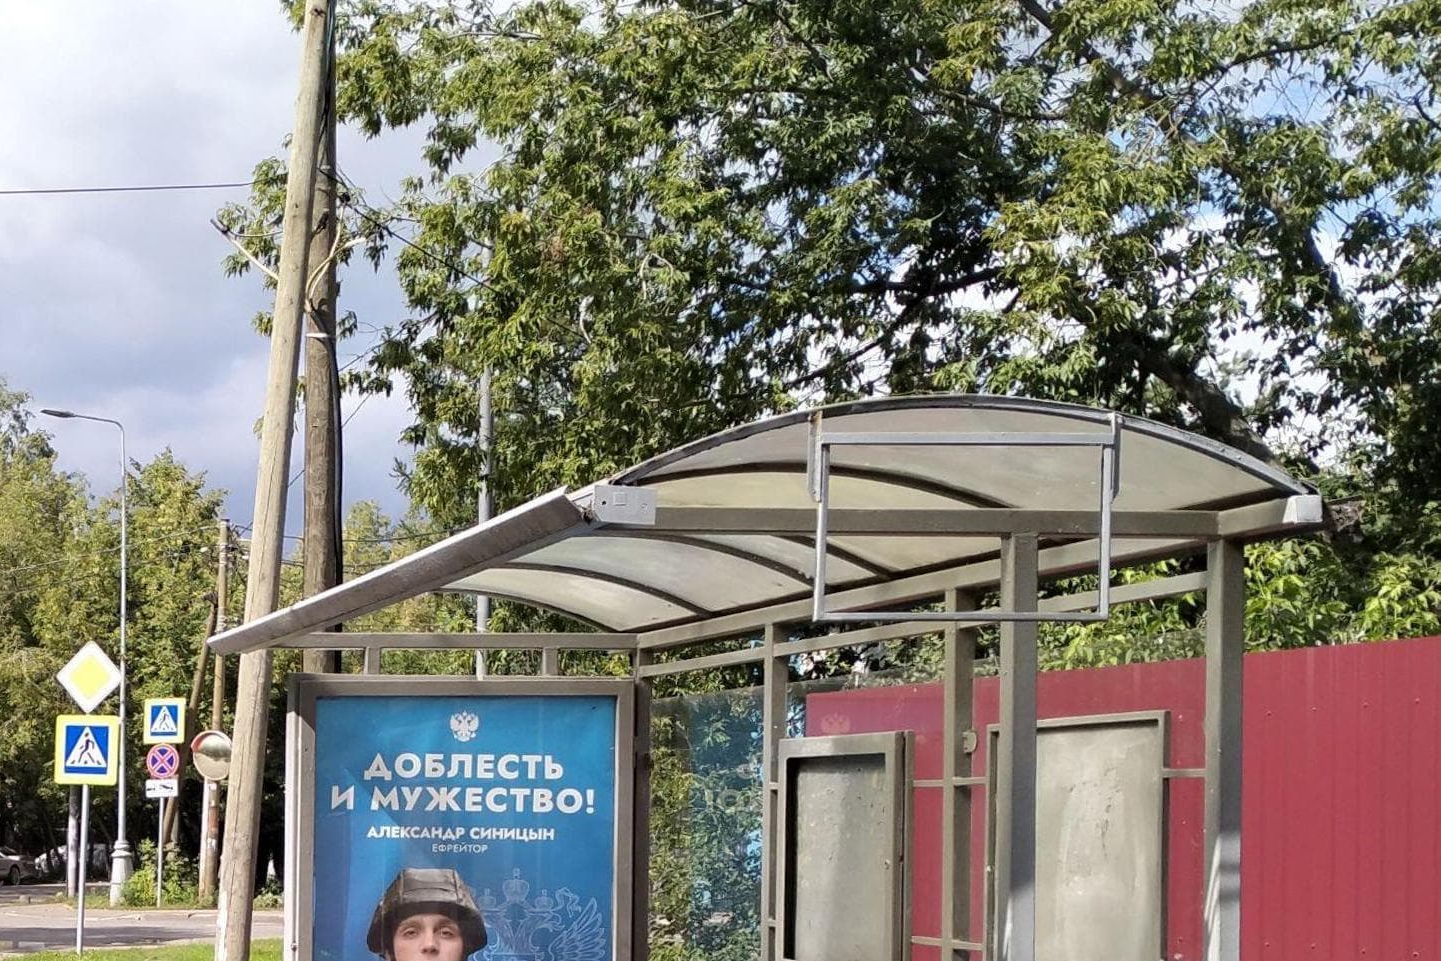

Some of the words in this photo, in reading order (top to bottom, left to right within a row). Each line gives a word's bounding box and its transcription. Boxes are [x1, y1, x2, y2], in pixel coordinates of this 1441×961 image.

[363, 752, 564, 780] ДОБЛЕСТЬ
[331, 785, 355, 810] И
[370, 787, 595, 814] МУЖЕСТВО!
[366, 826, 465, 841] АЛЕКСАНДР
[470, 828, 555, 842] СИНИЦЫН
[431, 842, 488, 854] ЕФРЕЙТОР
